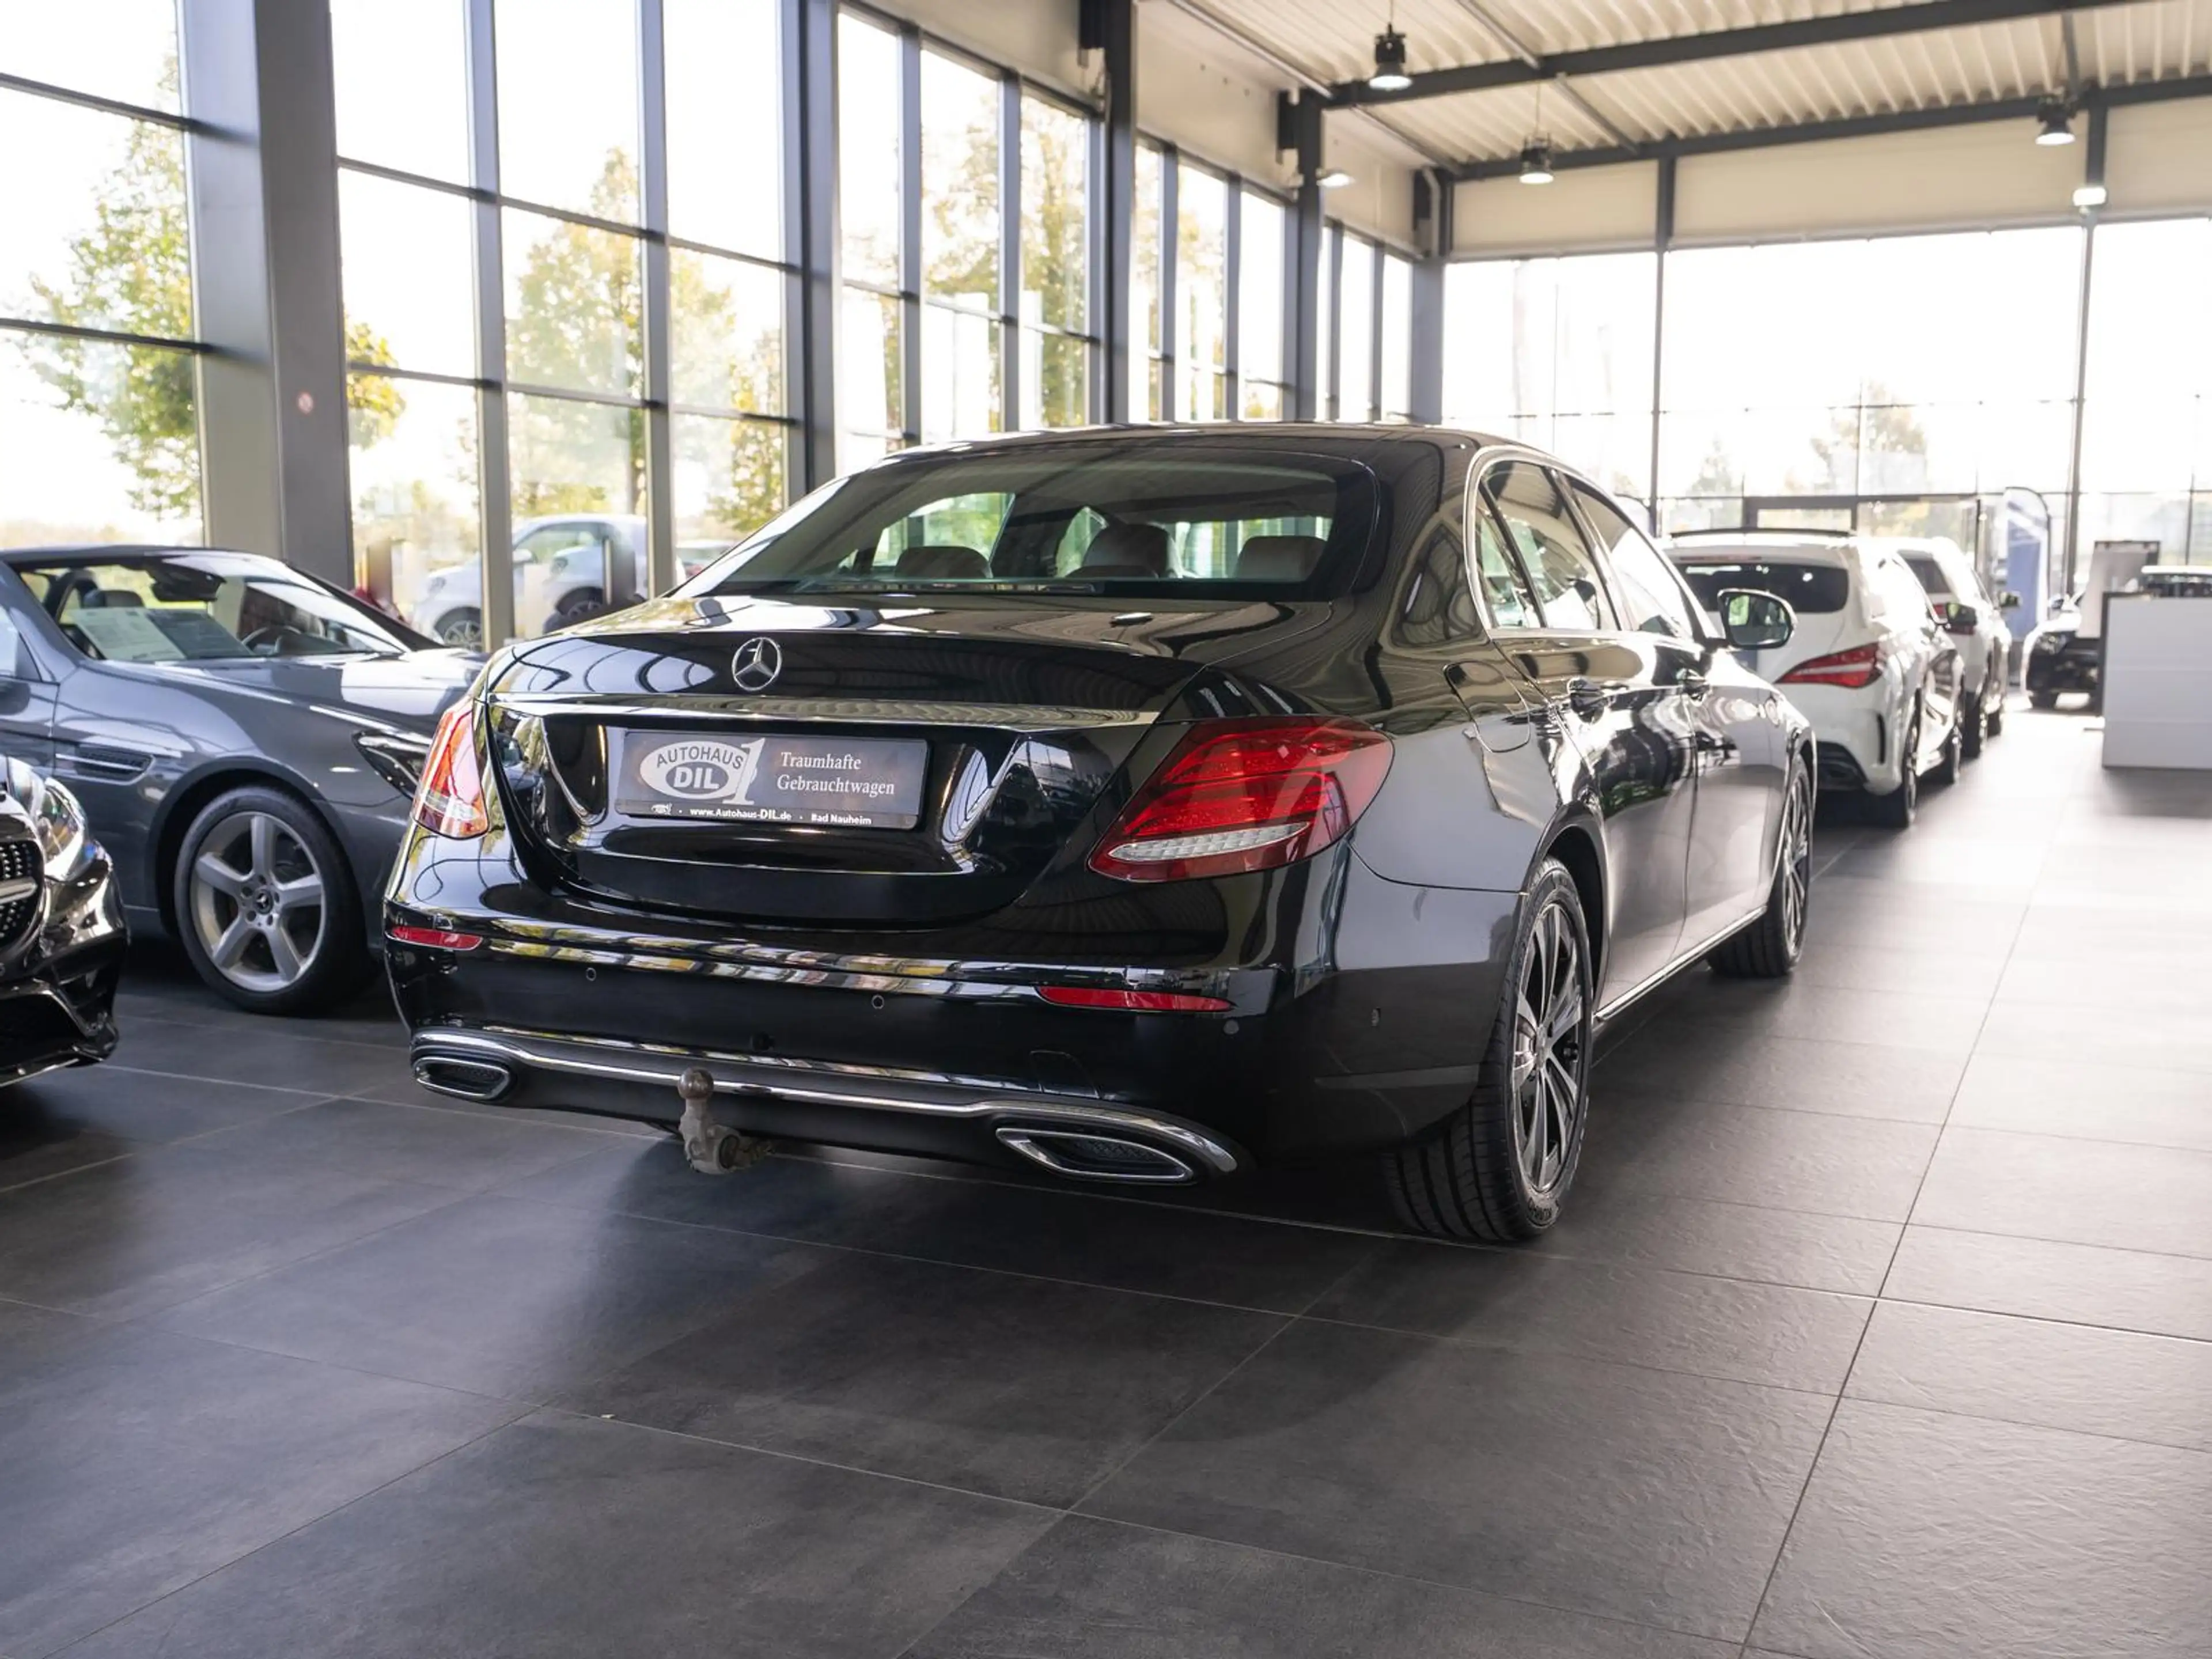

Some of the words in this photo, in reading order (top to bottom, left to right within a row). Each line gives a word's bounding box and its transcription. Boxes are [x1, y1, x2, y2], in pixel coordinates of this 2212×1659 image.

[656, 746, 744, 770] AUTOHAUS
[781, 751, 862, 770] Traumhafte
[673, 766, 720, 789] DIL
[777, 774, 895, 798] Gebrauchtwagen
[690, 808, 792, 821] www.Autohaus-DIL.de
[810, 813, 829, 823] Bad
[830, 813, 872, 825] Nauheim
